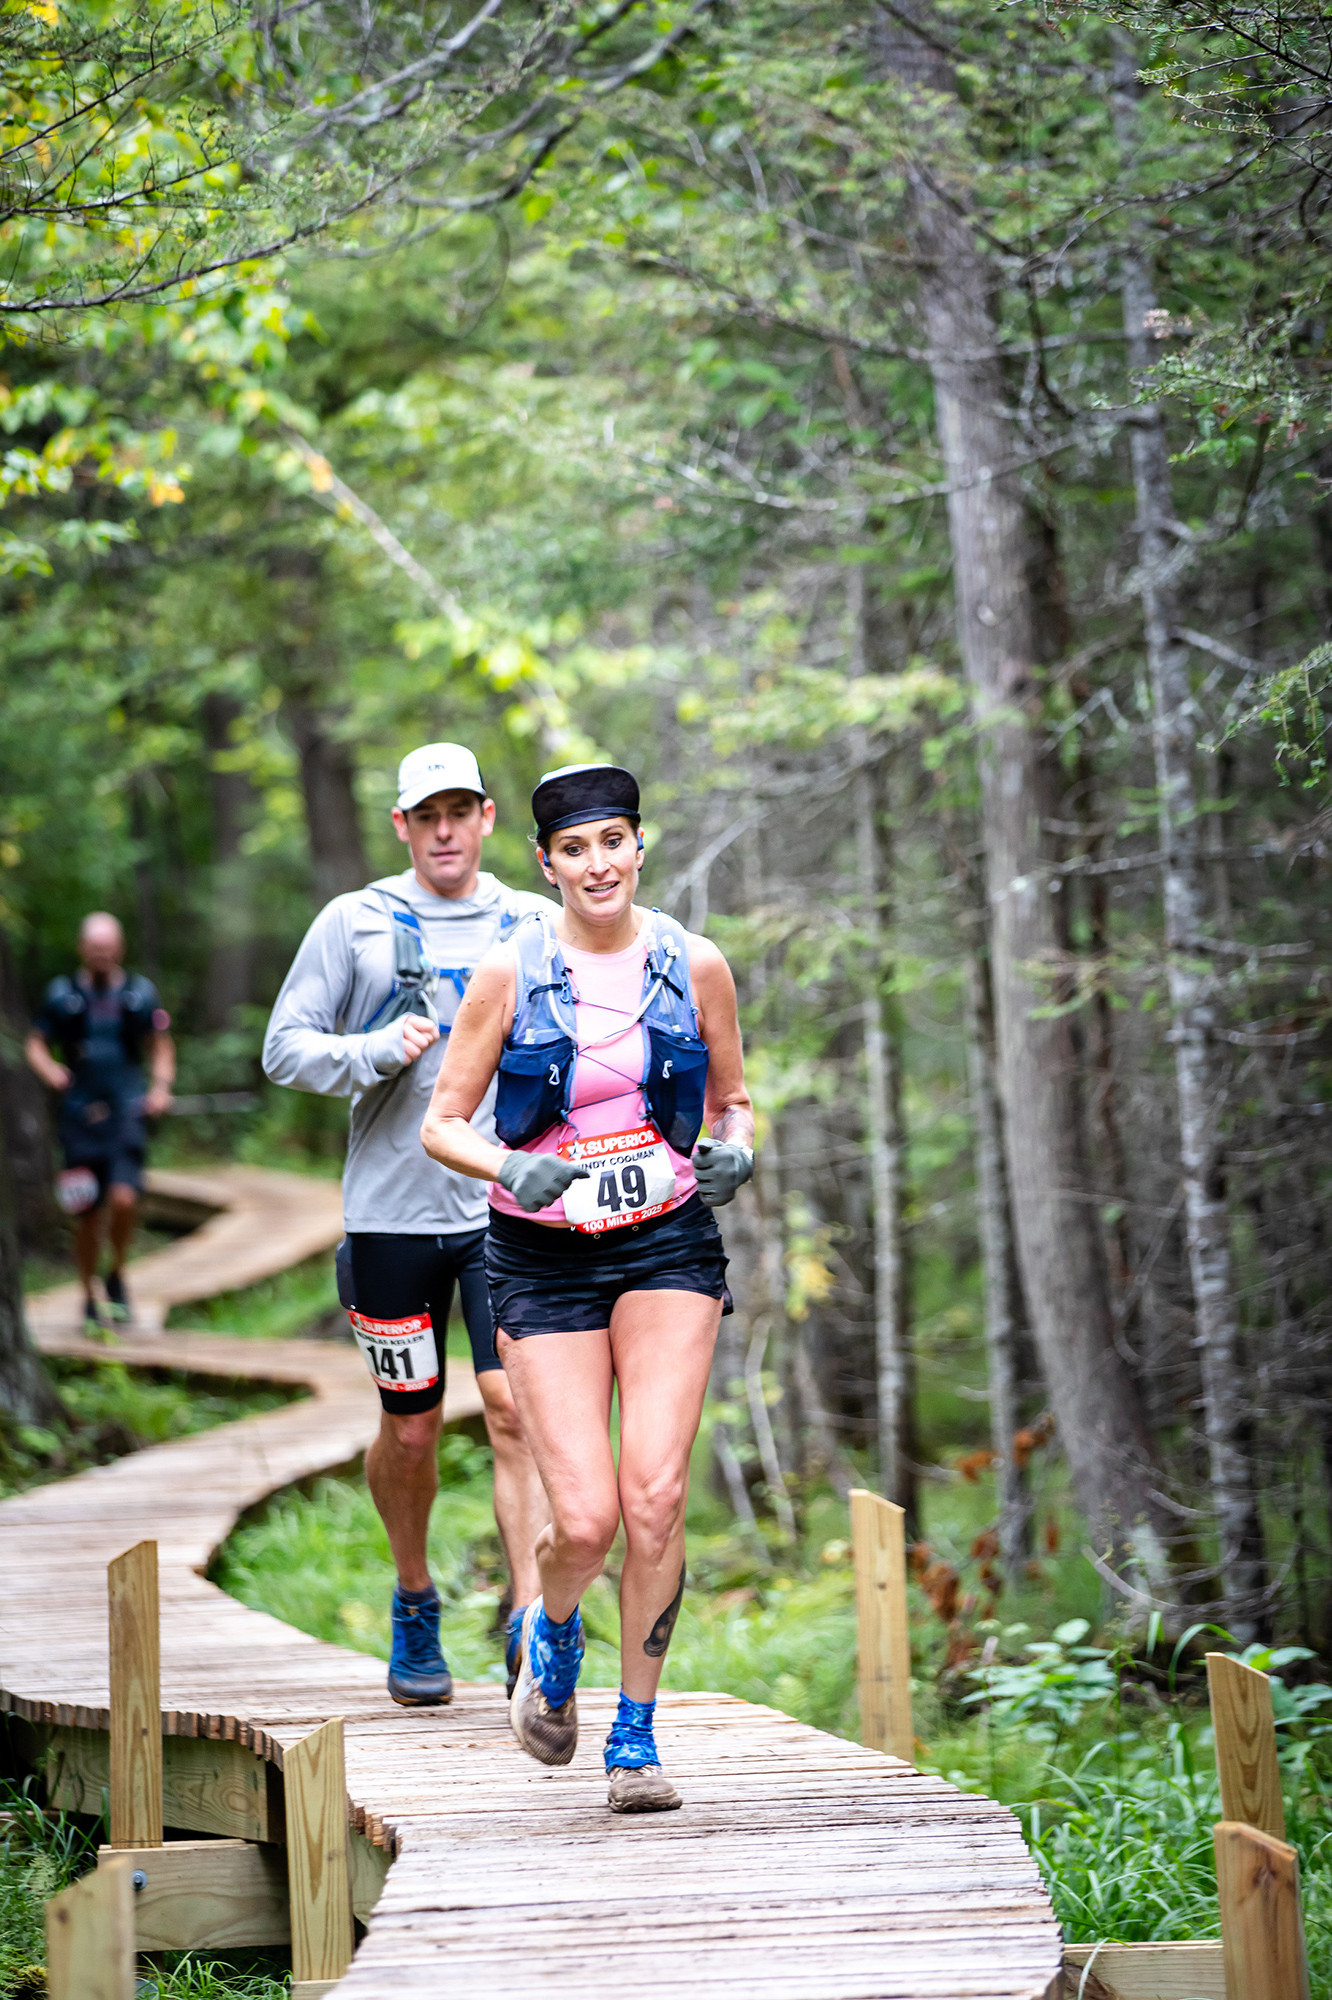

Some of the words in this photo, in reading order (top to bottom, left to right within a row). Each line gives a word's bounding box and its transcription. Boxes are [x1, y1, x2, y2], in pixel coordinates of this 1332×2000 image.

[586, 1131, 655, 1155] SUPERIOR
[580, 1159, 606, 1170] INDY
[610, 1149, 655, 1165] COOLMAN
[597, 1165, 647, 1212] 49
[583, 1222, 604, 1232] 100
[607, 1214, 633, 1227] MILE
[641, 1204, 663, 1218] 2025
[362, 1319, 422, 1335] SUPERIOR
[390, 1336, 424, 1346] KELLER
[367, 1345, 415, 1380] 141
[405, 1381, 430, 1391] 2025
